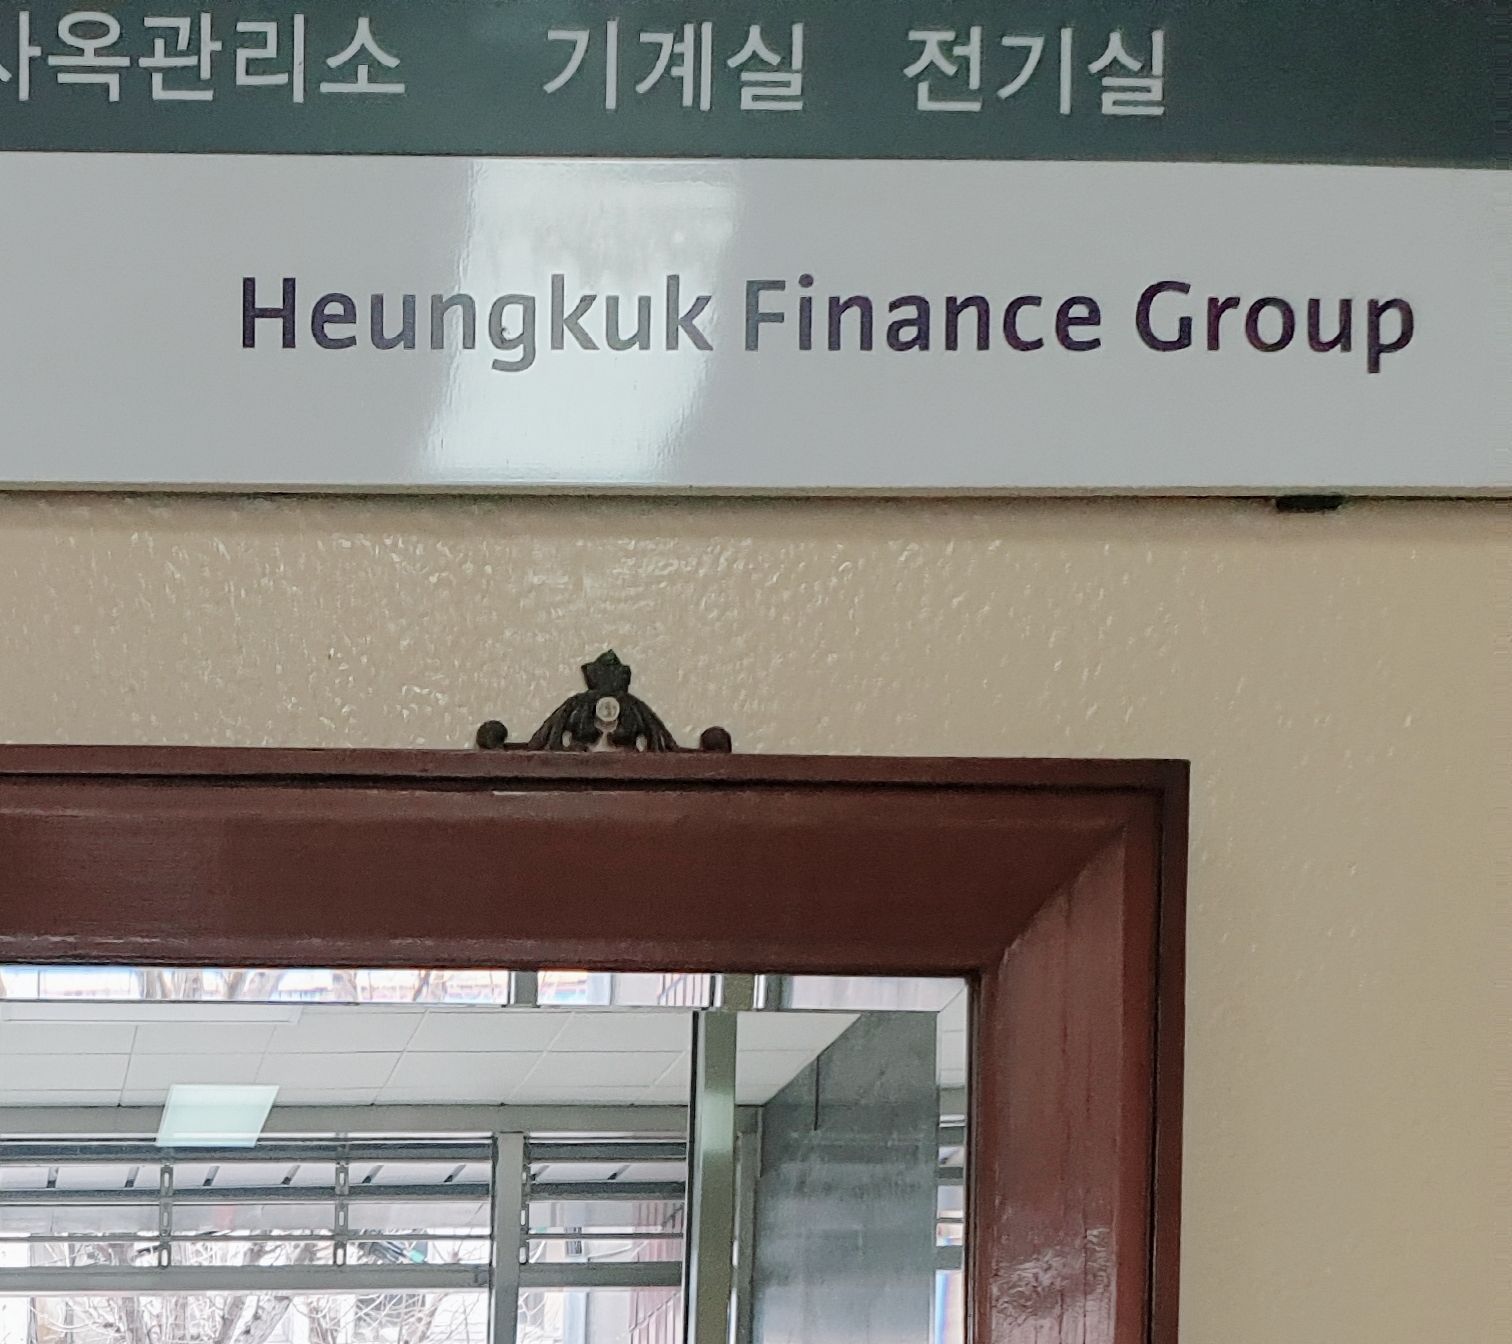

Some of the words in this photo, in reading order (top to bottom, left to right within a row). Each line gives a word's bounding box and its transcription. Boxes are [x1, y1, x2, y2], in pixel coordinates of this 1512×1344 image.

[542, 17, 806, 112] 기계실
[902, 27, 1166, 117] 전기실
[240, 275, 713, 371] Heungkuk
[744, 274, 1102, 353] Finance
[1136, 280, 1417, 373] Group
